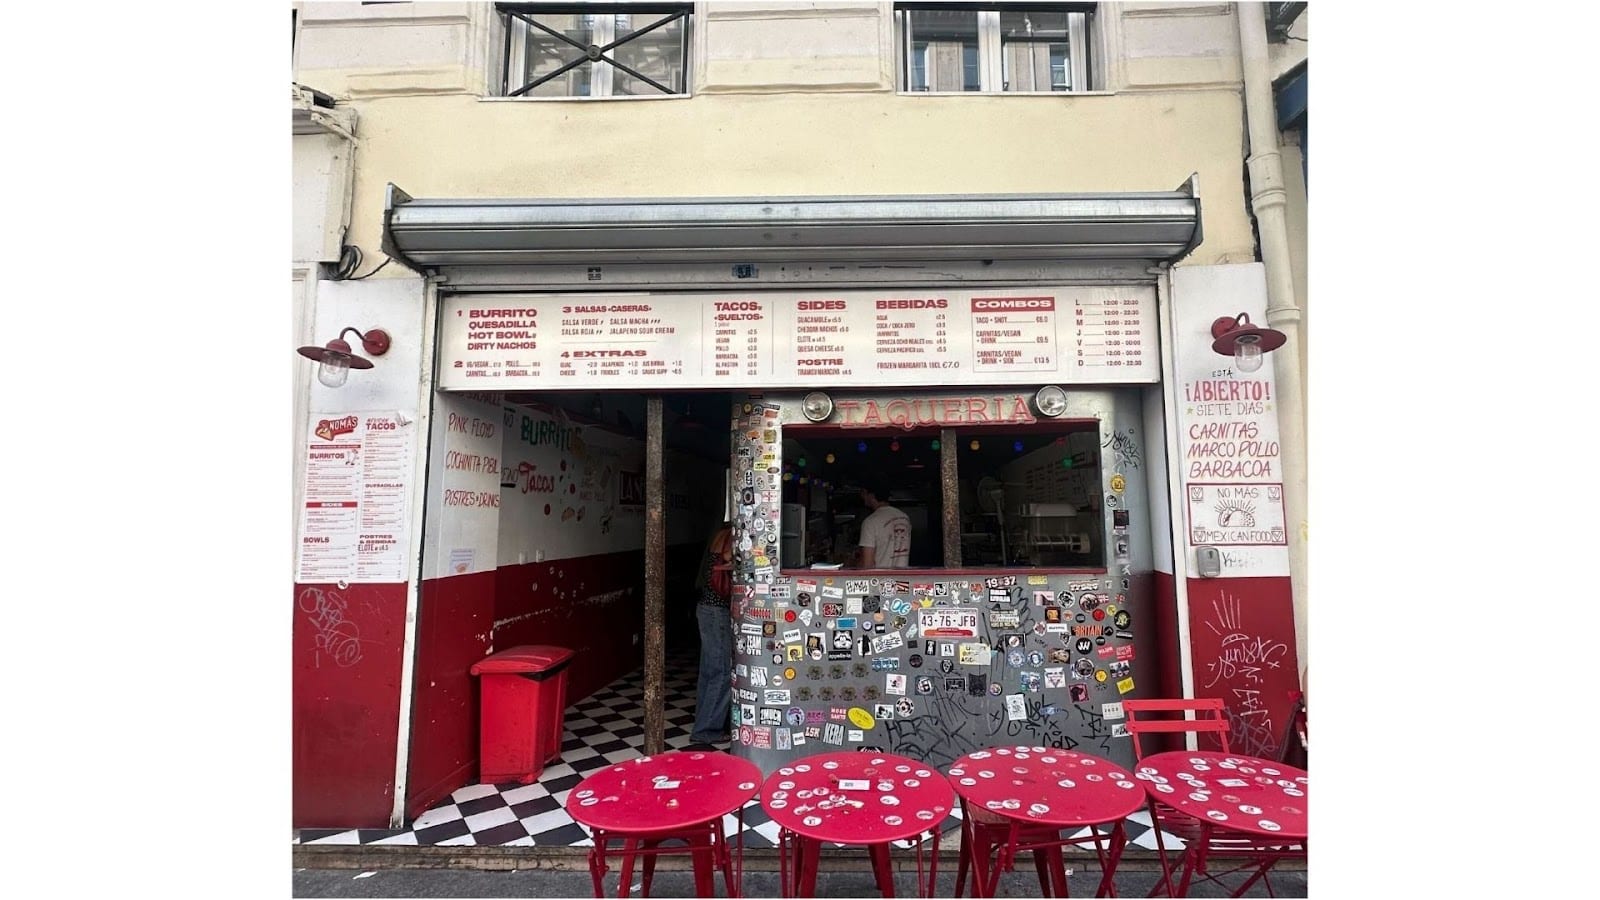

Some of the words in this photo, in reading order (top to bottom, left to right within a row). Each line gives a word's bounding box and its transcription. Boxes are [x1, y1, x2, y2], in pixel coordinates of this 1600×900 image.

[714, 301, 758, 311] TACOS
[797, 300, 846, 311] SIDES
[876, 299, 948, 310] BEBIDAS
[975, 300, 1052, 308] COMBOS
[469, 309, 538, 318] BURRITO
[468, 320, 537, 329] QUESADILLA
[581, 318, 599, 326] VERDE
[976, 316, 989, 324] TACO
[994, 316, 1008, 324] SHOT
[468, 331, 494, 340] HOT
[467, 342, 495, 350] DIRTY
[496, 341, 537, 350] NACHOS
[560, 351, 570, 359] 4
[797, 358, 844, 366] POSTRE
[981, 357, 998, 365] DRINK
[1185, 380, 1271, 402] ¡ABIERTO!
[836, 394, 1037, 429] TAQUERIA
[1196, 402, 1232, 417] SIETE
[365, 422, 396, 431] TACOS
[447, 412, 470, 434] PINK
[471, 418, 496, 439] FLOYD
[1189, 421, 1259, 440] CARNITAS
[1187, 441, 1236, 459] MARCO
[1238, 440, 1279, 458] POLLO
[309, 452, 345, 460] BURRITOS
[1189, 459, 1272, 479] BARBACOA
[518, 461, 555, 494] Tacos
[1217, 488, 1231, 499] NO
[1206, 531, 1249, 543] MEXICAN
[1249, 530, 1272, 542] FOOD
[358, 543, 374, 552] ELOTE
